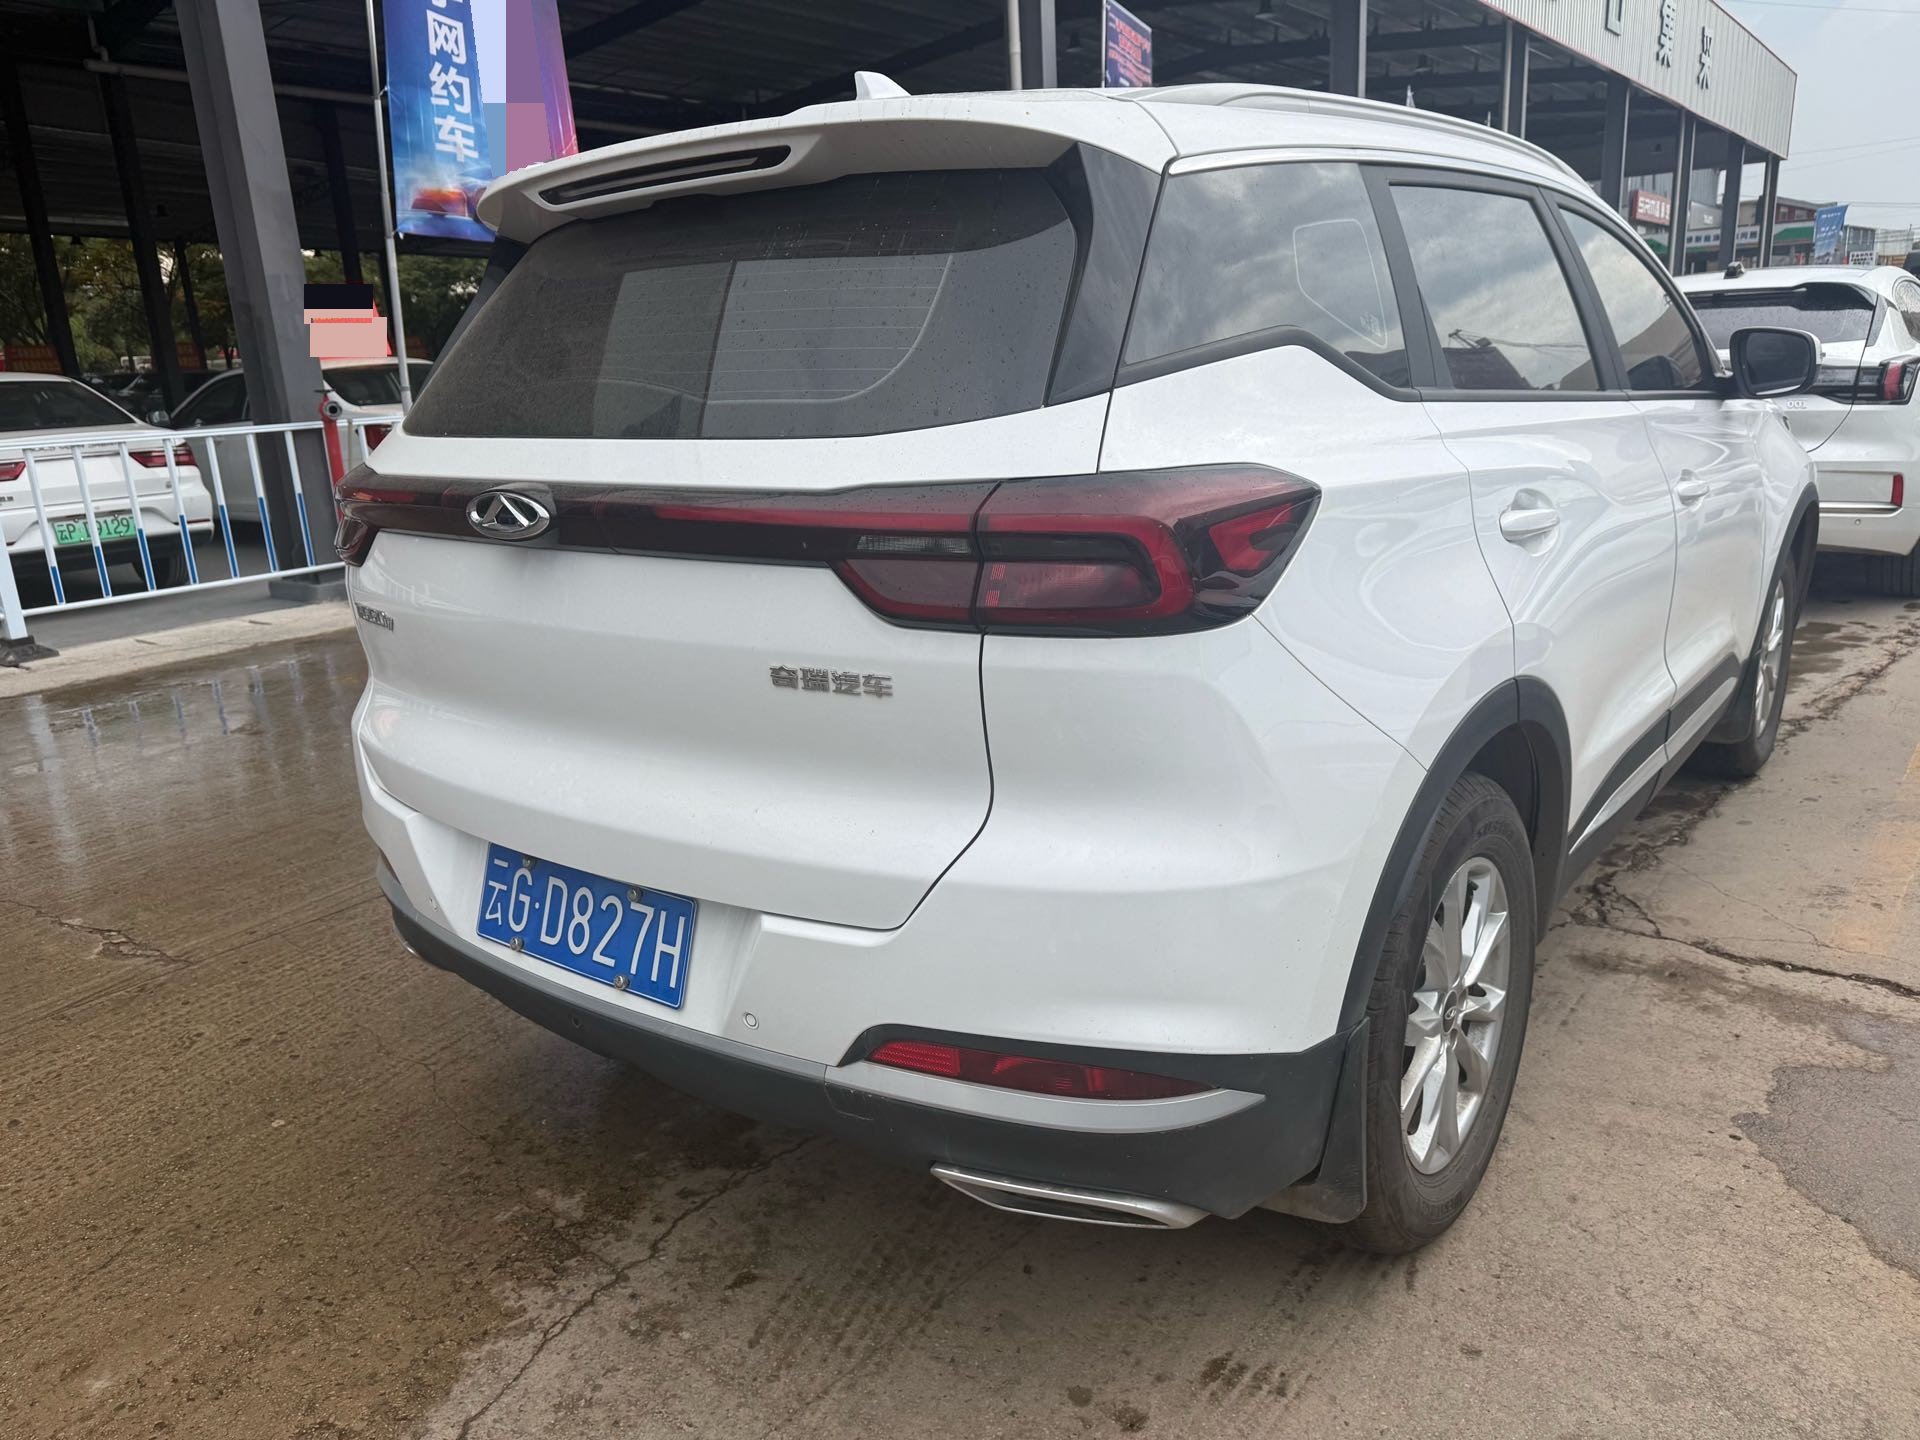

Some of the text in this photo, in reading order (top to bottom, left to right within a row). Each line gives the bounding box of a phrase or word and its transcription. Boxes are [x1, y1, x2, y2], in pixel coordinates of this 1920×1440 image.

[426, 0, 479, 163] 网约车
[769, 665, 894, 698] 奇瑞汽车
